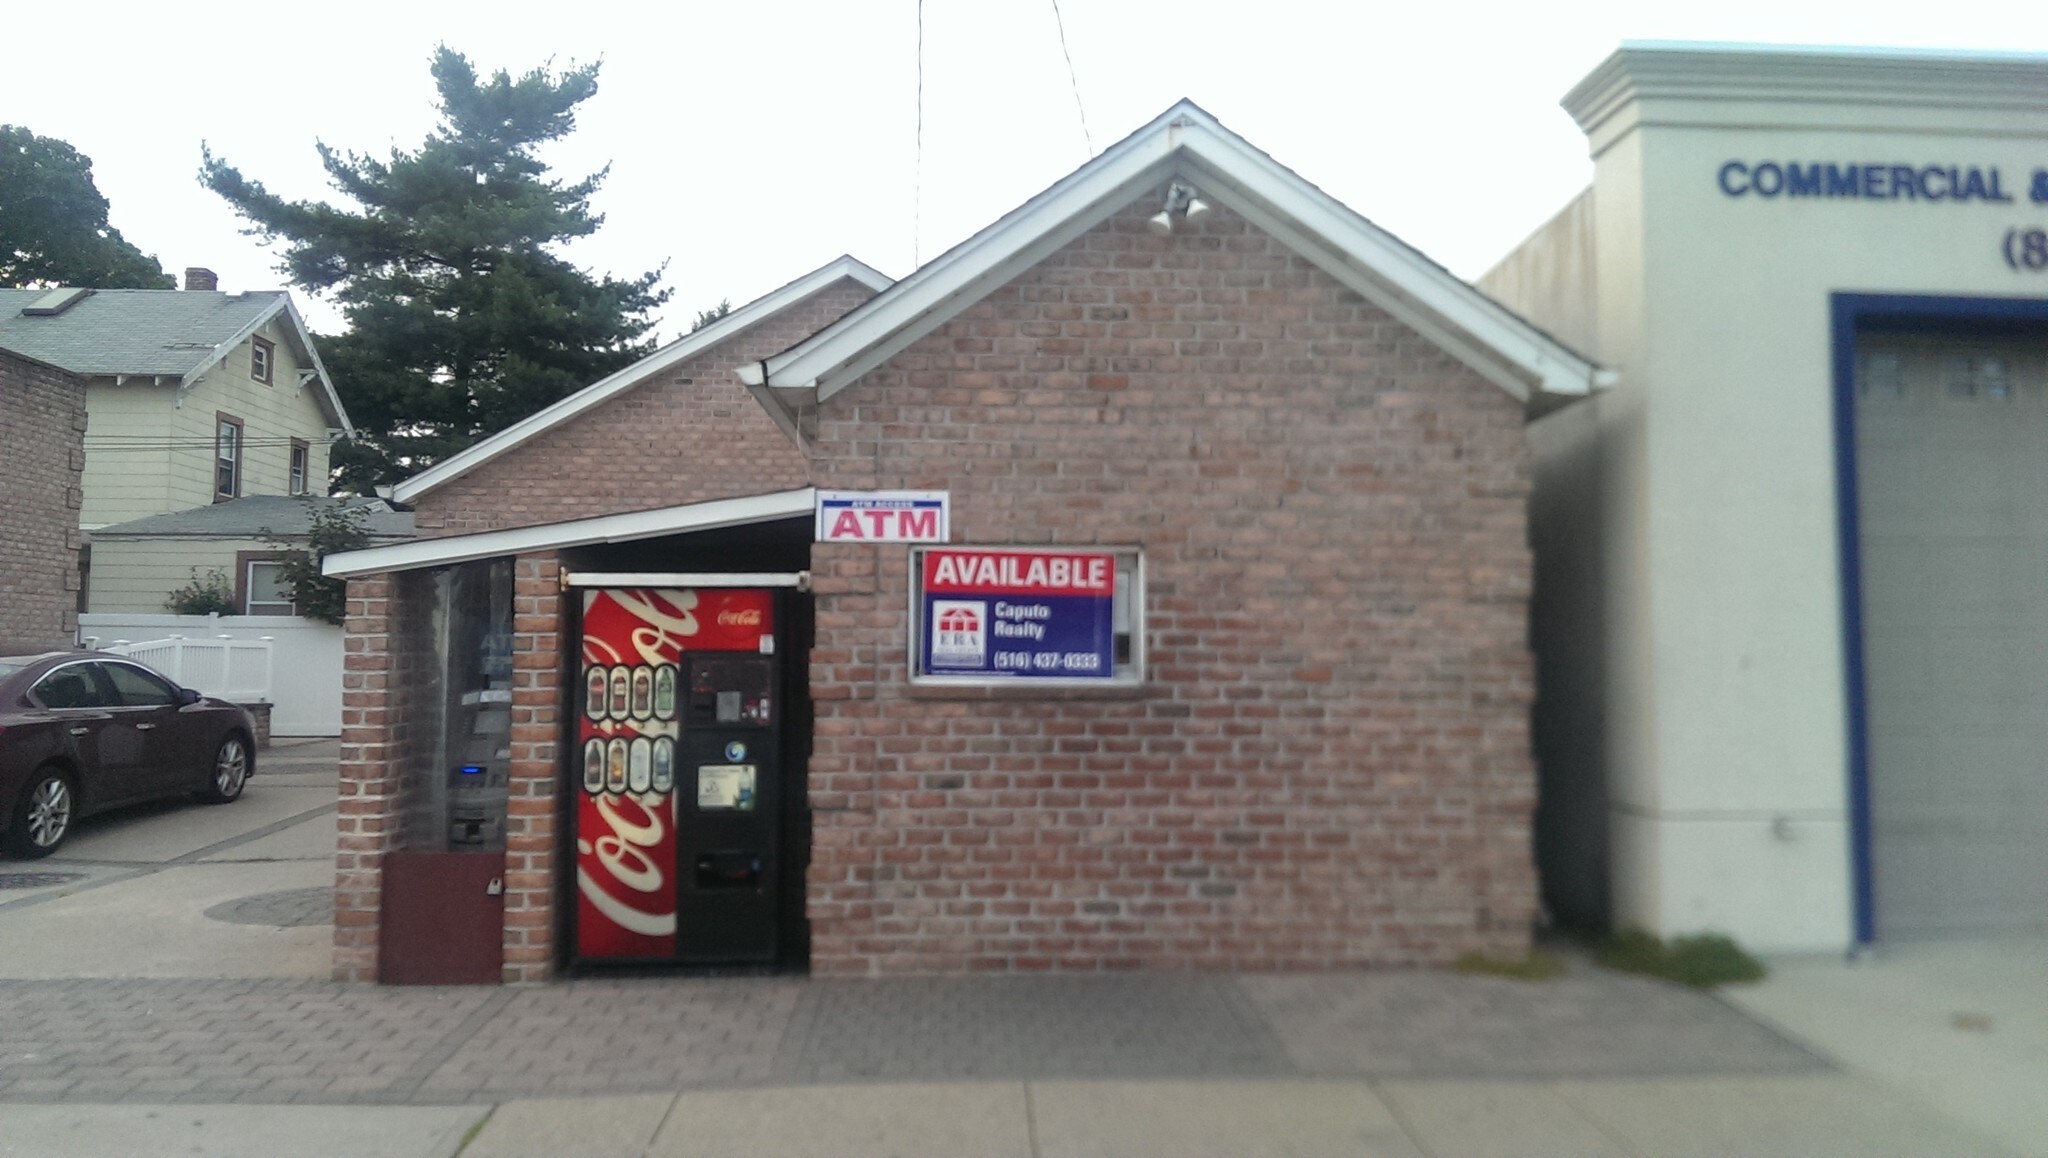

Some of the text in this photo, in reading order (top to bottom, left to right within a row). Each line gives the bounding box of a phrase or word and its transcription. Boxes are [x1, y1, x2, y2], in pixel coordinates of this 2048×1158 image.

[1717, 161, 2013, 204] COMMERCIAL
[830, 510, 937, 538] ATM
[933, 556, 1107, 588] AVAILABLE
[994, 601, 1051, 622] Caputo
[994, 619, 1047, 641] Realty
[993, 650, 1031, 670] (516)
[1032, 651, 1101, 670] 437-0333
